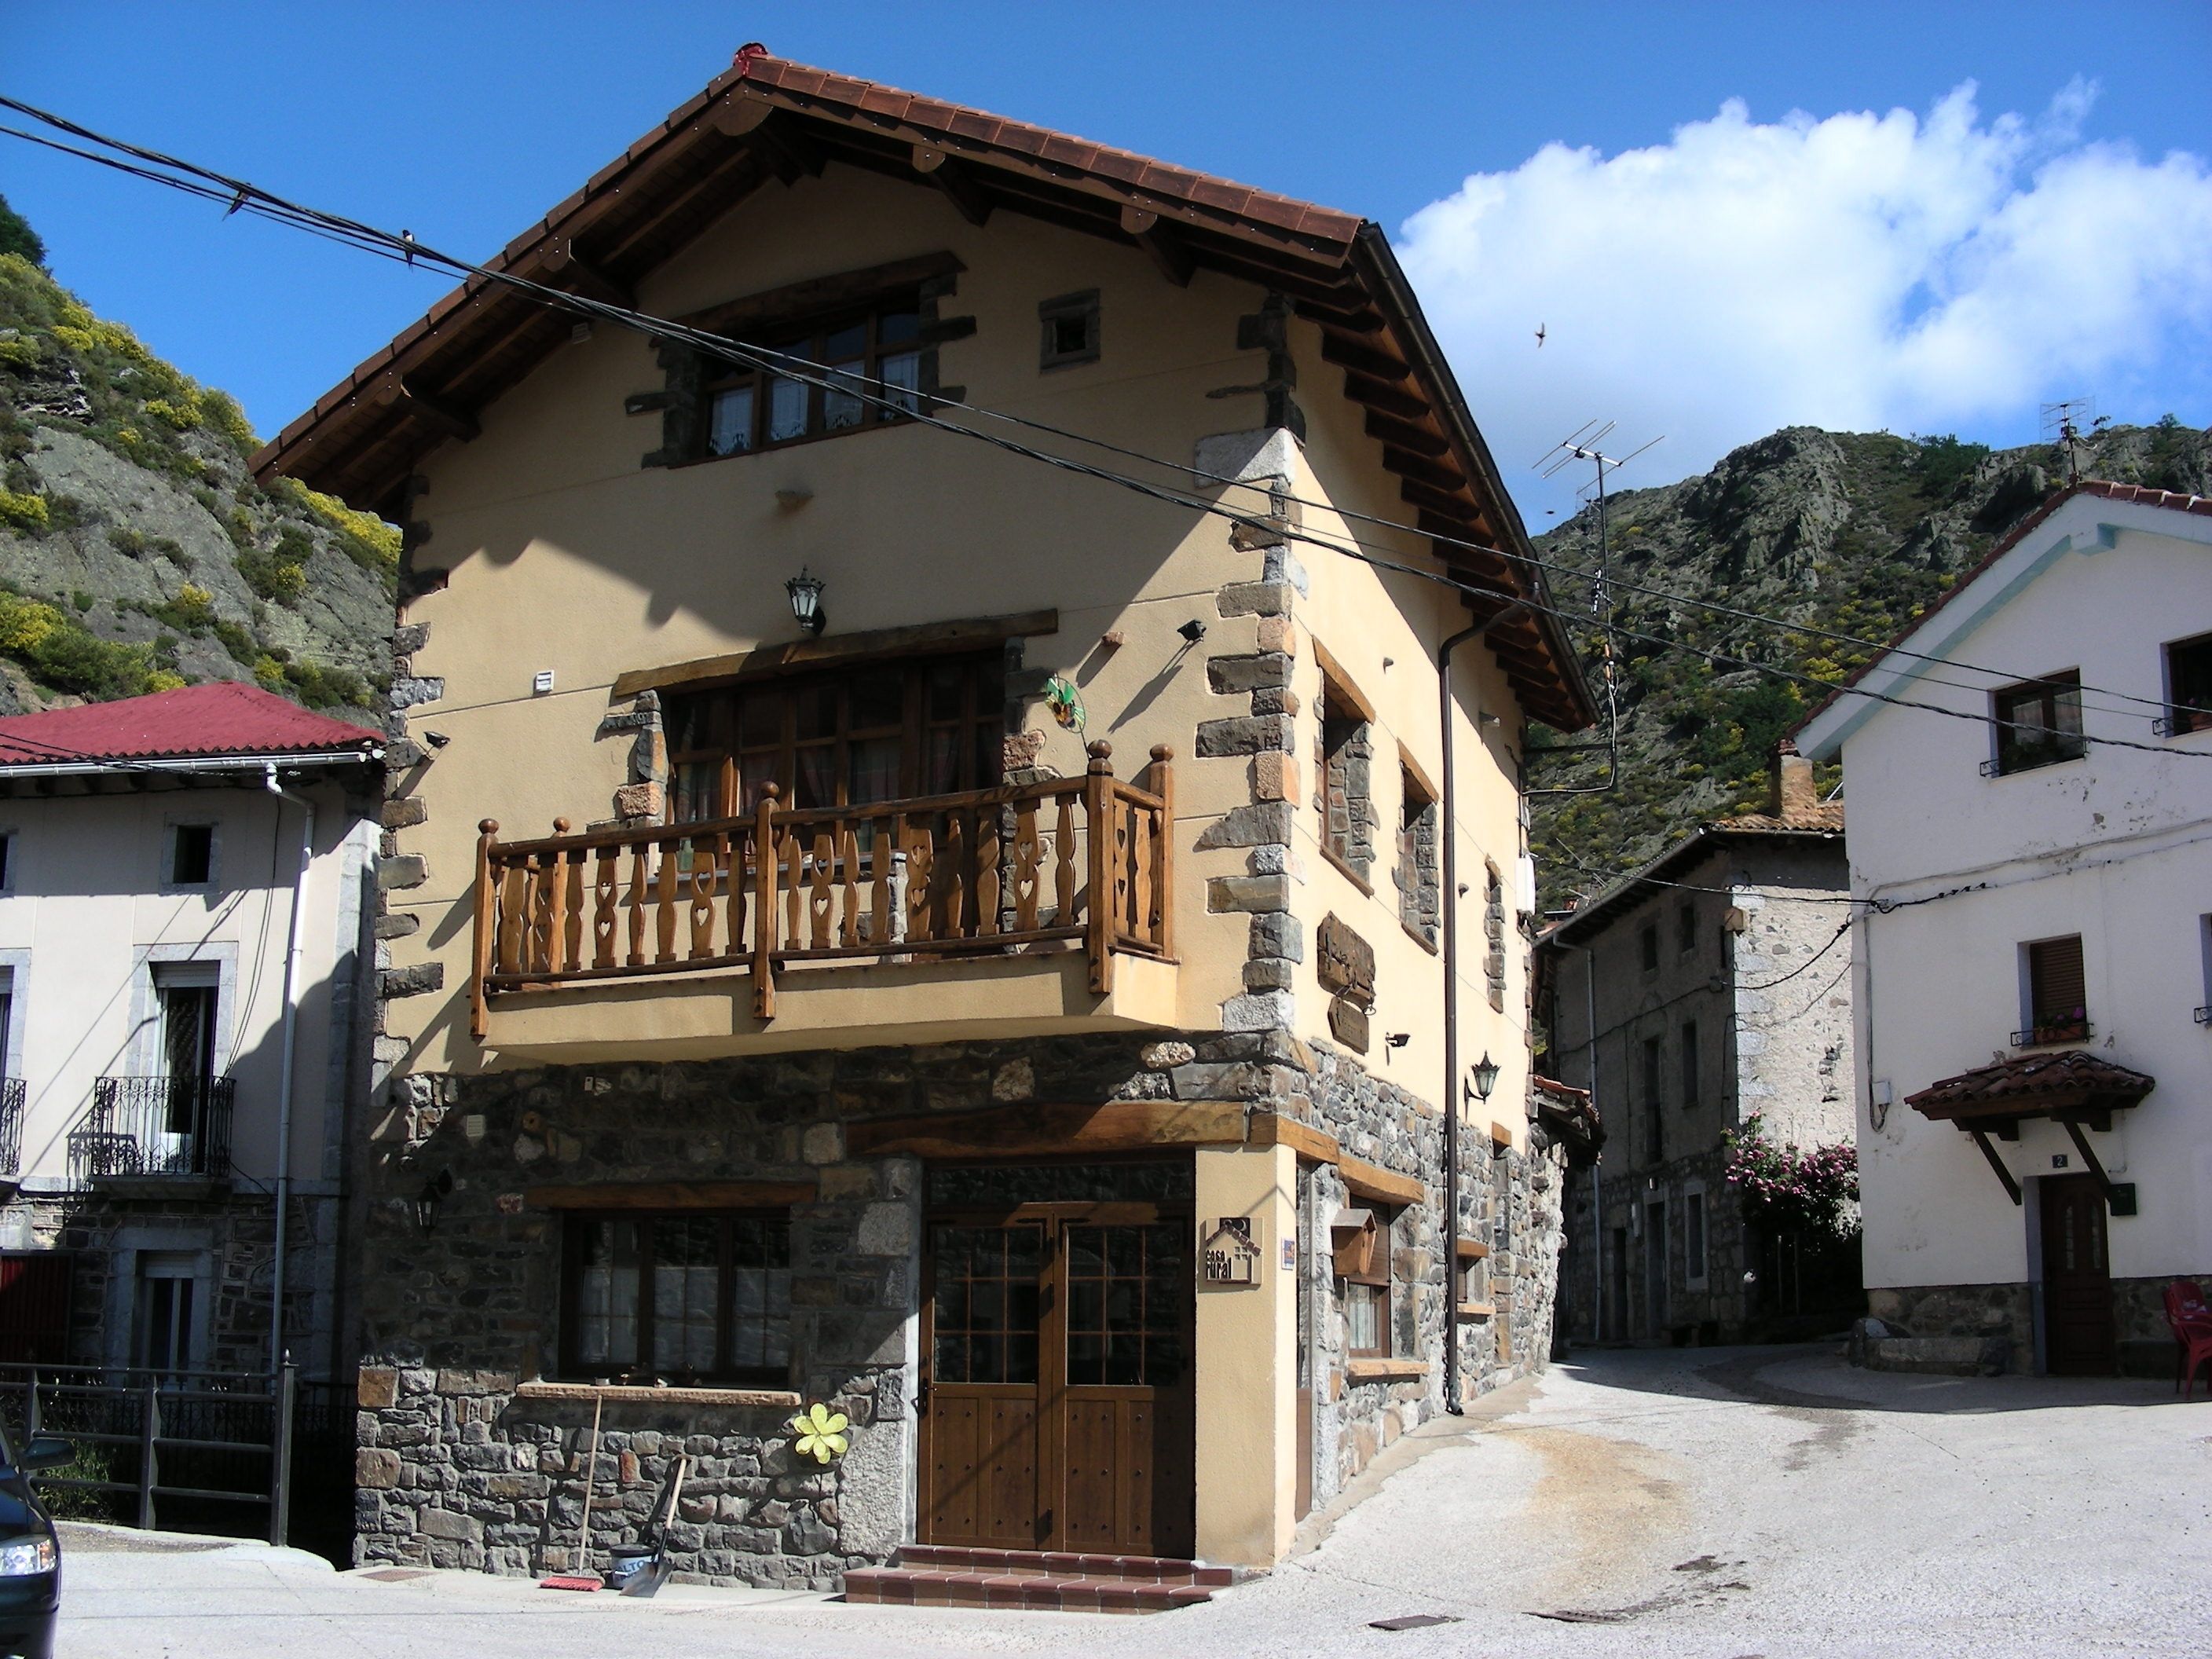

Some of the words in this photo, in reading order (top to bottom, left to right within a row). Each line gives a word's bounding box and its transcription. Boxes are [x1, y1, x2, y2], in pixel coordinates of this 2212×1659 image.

[2056, 1155, 2064, 1167] 2
[1206, 1250, 1225, 1262] casa
[1206, 1257, 1232, 1279] rural
